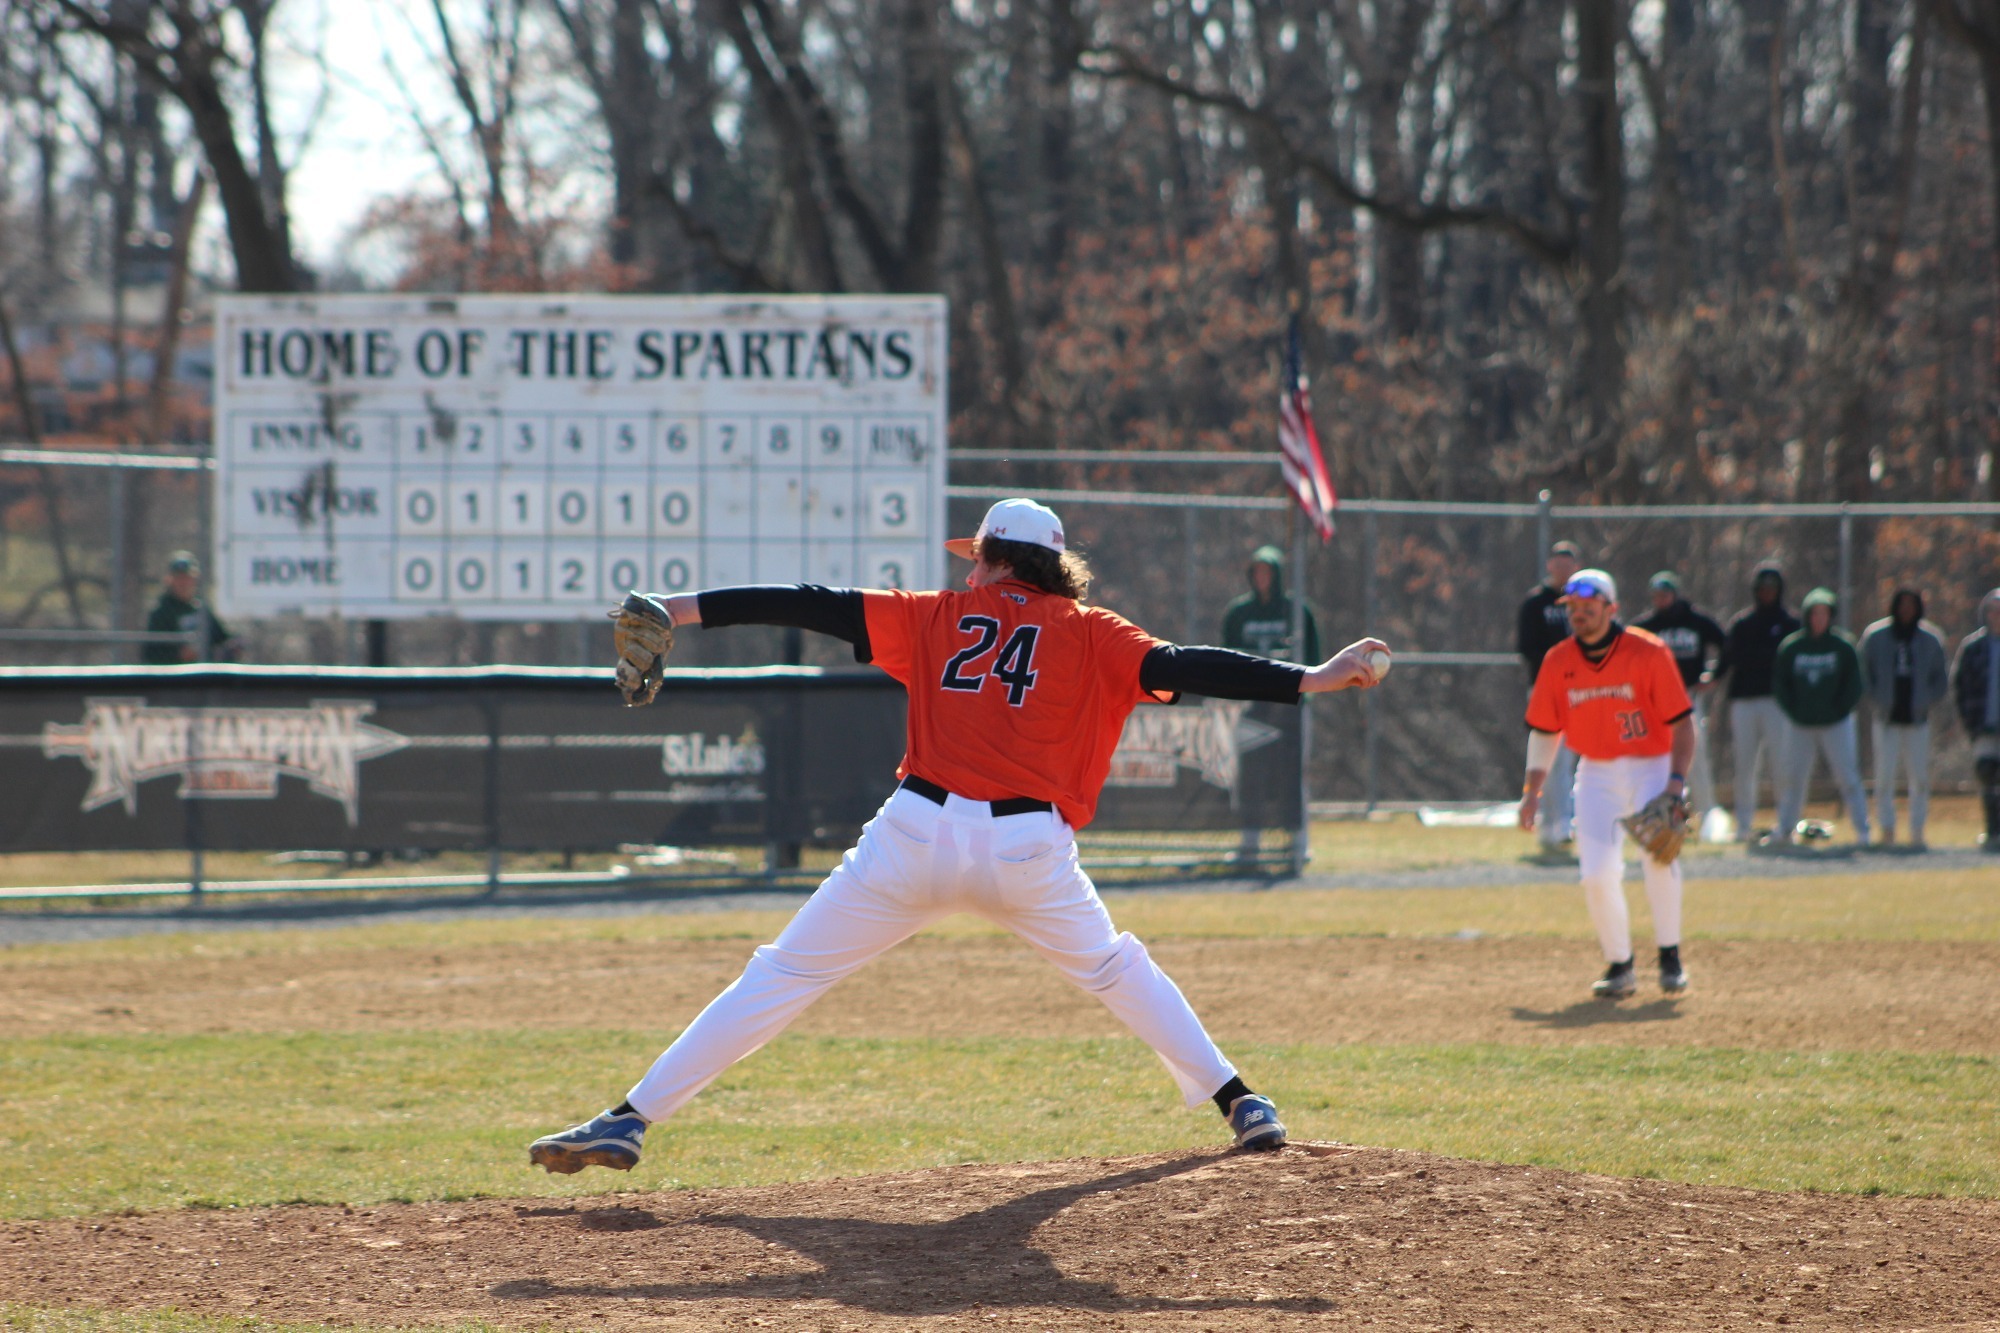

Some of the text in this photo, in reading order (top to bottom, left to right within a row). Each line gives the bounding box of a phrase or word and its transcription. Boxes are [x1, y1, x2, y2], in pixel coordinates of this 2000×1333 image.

[240, 329, 915, 380] HOME OF THE SPARTANS
[415, 425, 428, 451] 1
[466, 425, 483, 451] 2
[518, 425, 535, 451] 3
[565, 425, 582, 451] 4
[617, 424, 637, 451] 5
[666, 424, 688, 451] 6
[719, 425, 737, 451] 7
[769, 425, 790, 452] 8
[820, 425, 842, 452] 9
[251, 488, 908, 526] VISTOR 0 1 1 0 1 0 3
[251, 556, 903, 592] HOME 0 0 1 2 0 0 3
[940, 614, 1041, 707] 24
[1615, 709, 1648, 742] 30
